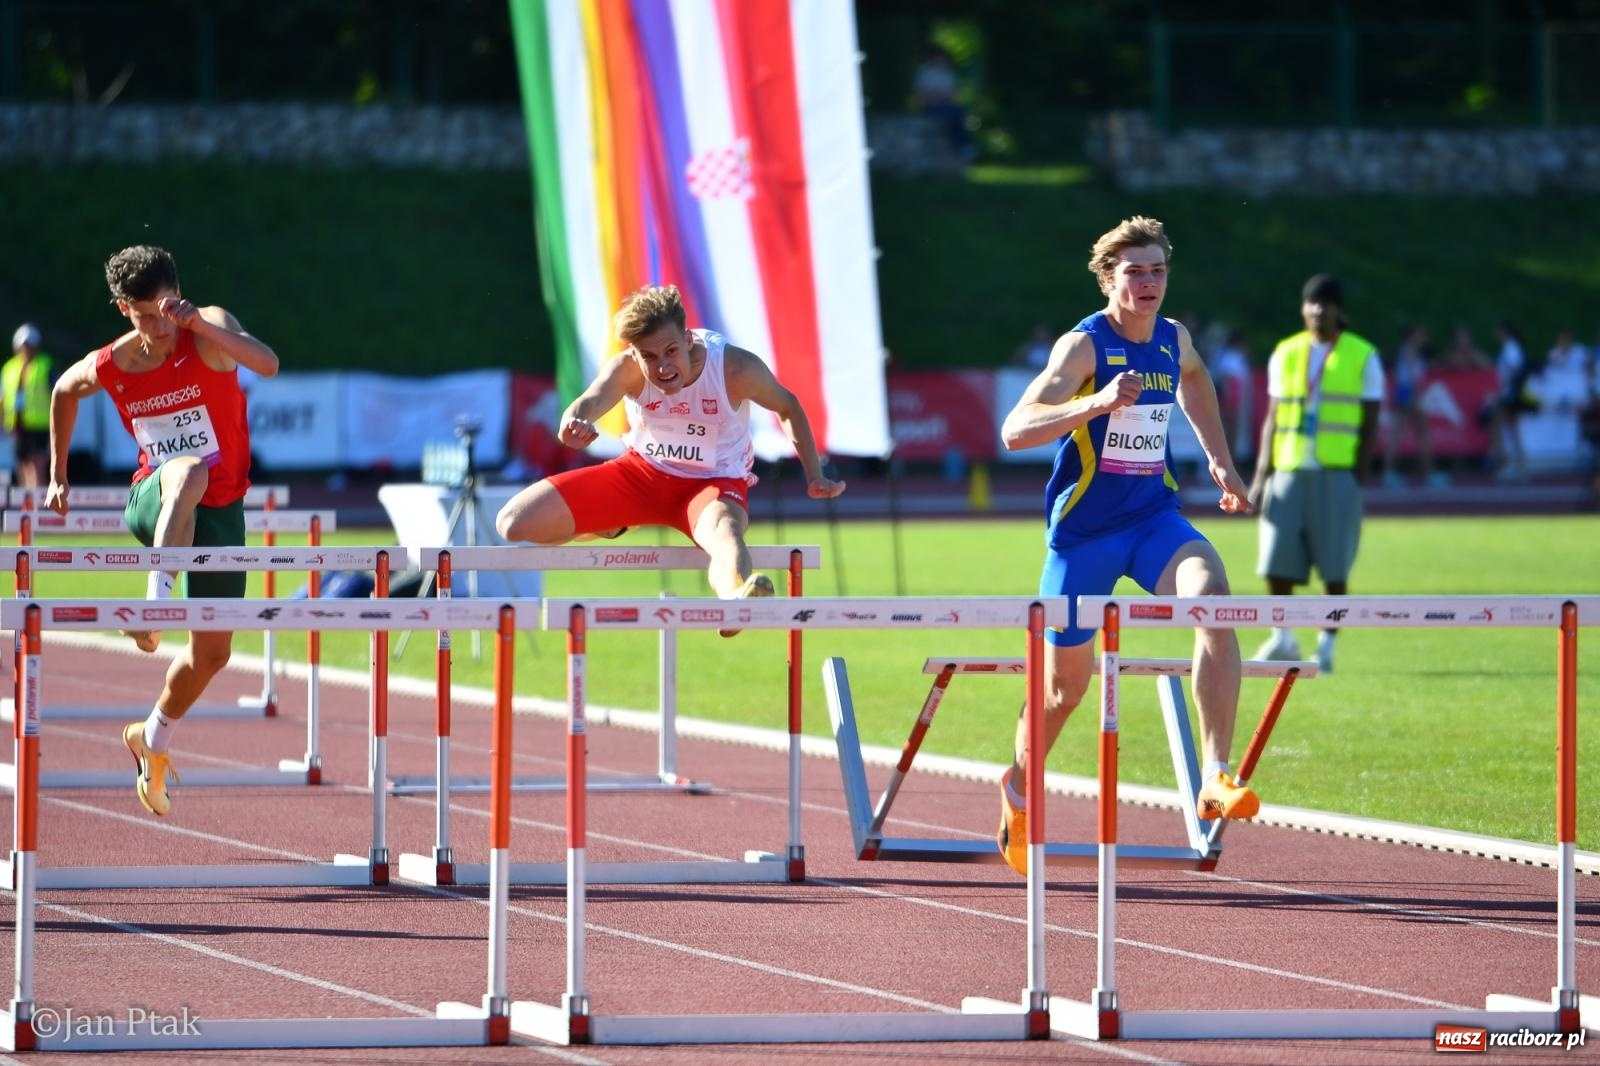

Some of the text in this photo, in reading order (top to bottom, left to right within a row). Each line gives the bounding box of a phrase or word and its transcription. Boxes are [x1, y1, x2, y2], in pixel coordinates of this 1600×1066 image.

[173, 409, 201, 428] 253
[687, 423, 706, 437] 53
[146, 431, 208, 457] TAKÁCS
[645, 443, 704, 461] SAMUL
[107, 554, 138, 563] ORLEN
[193, 554, 211, 565] 4F
[603, 551, 660, 567] polanik
[792, 609, 816, 622] 4F
[1217, 609, 1256, 620] ORLEN
[1325, 608, 1349, 621] 4F
